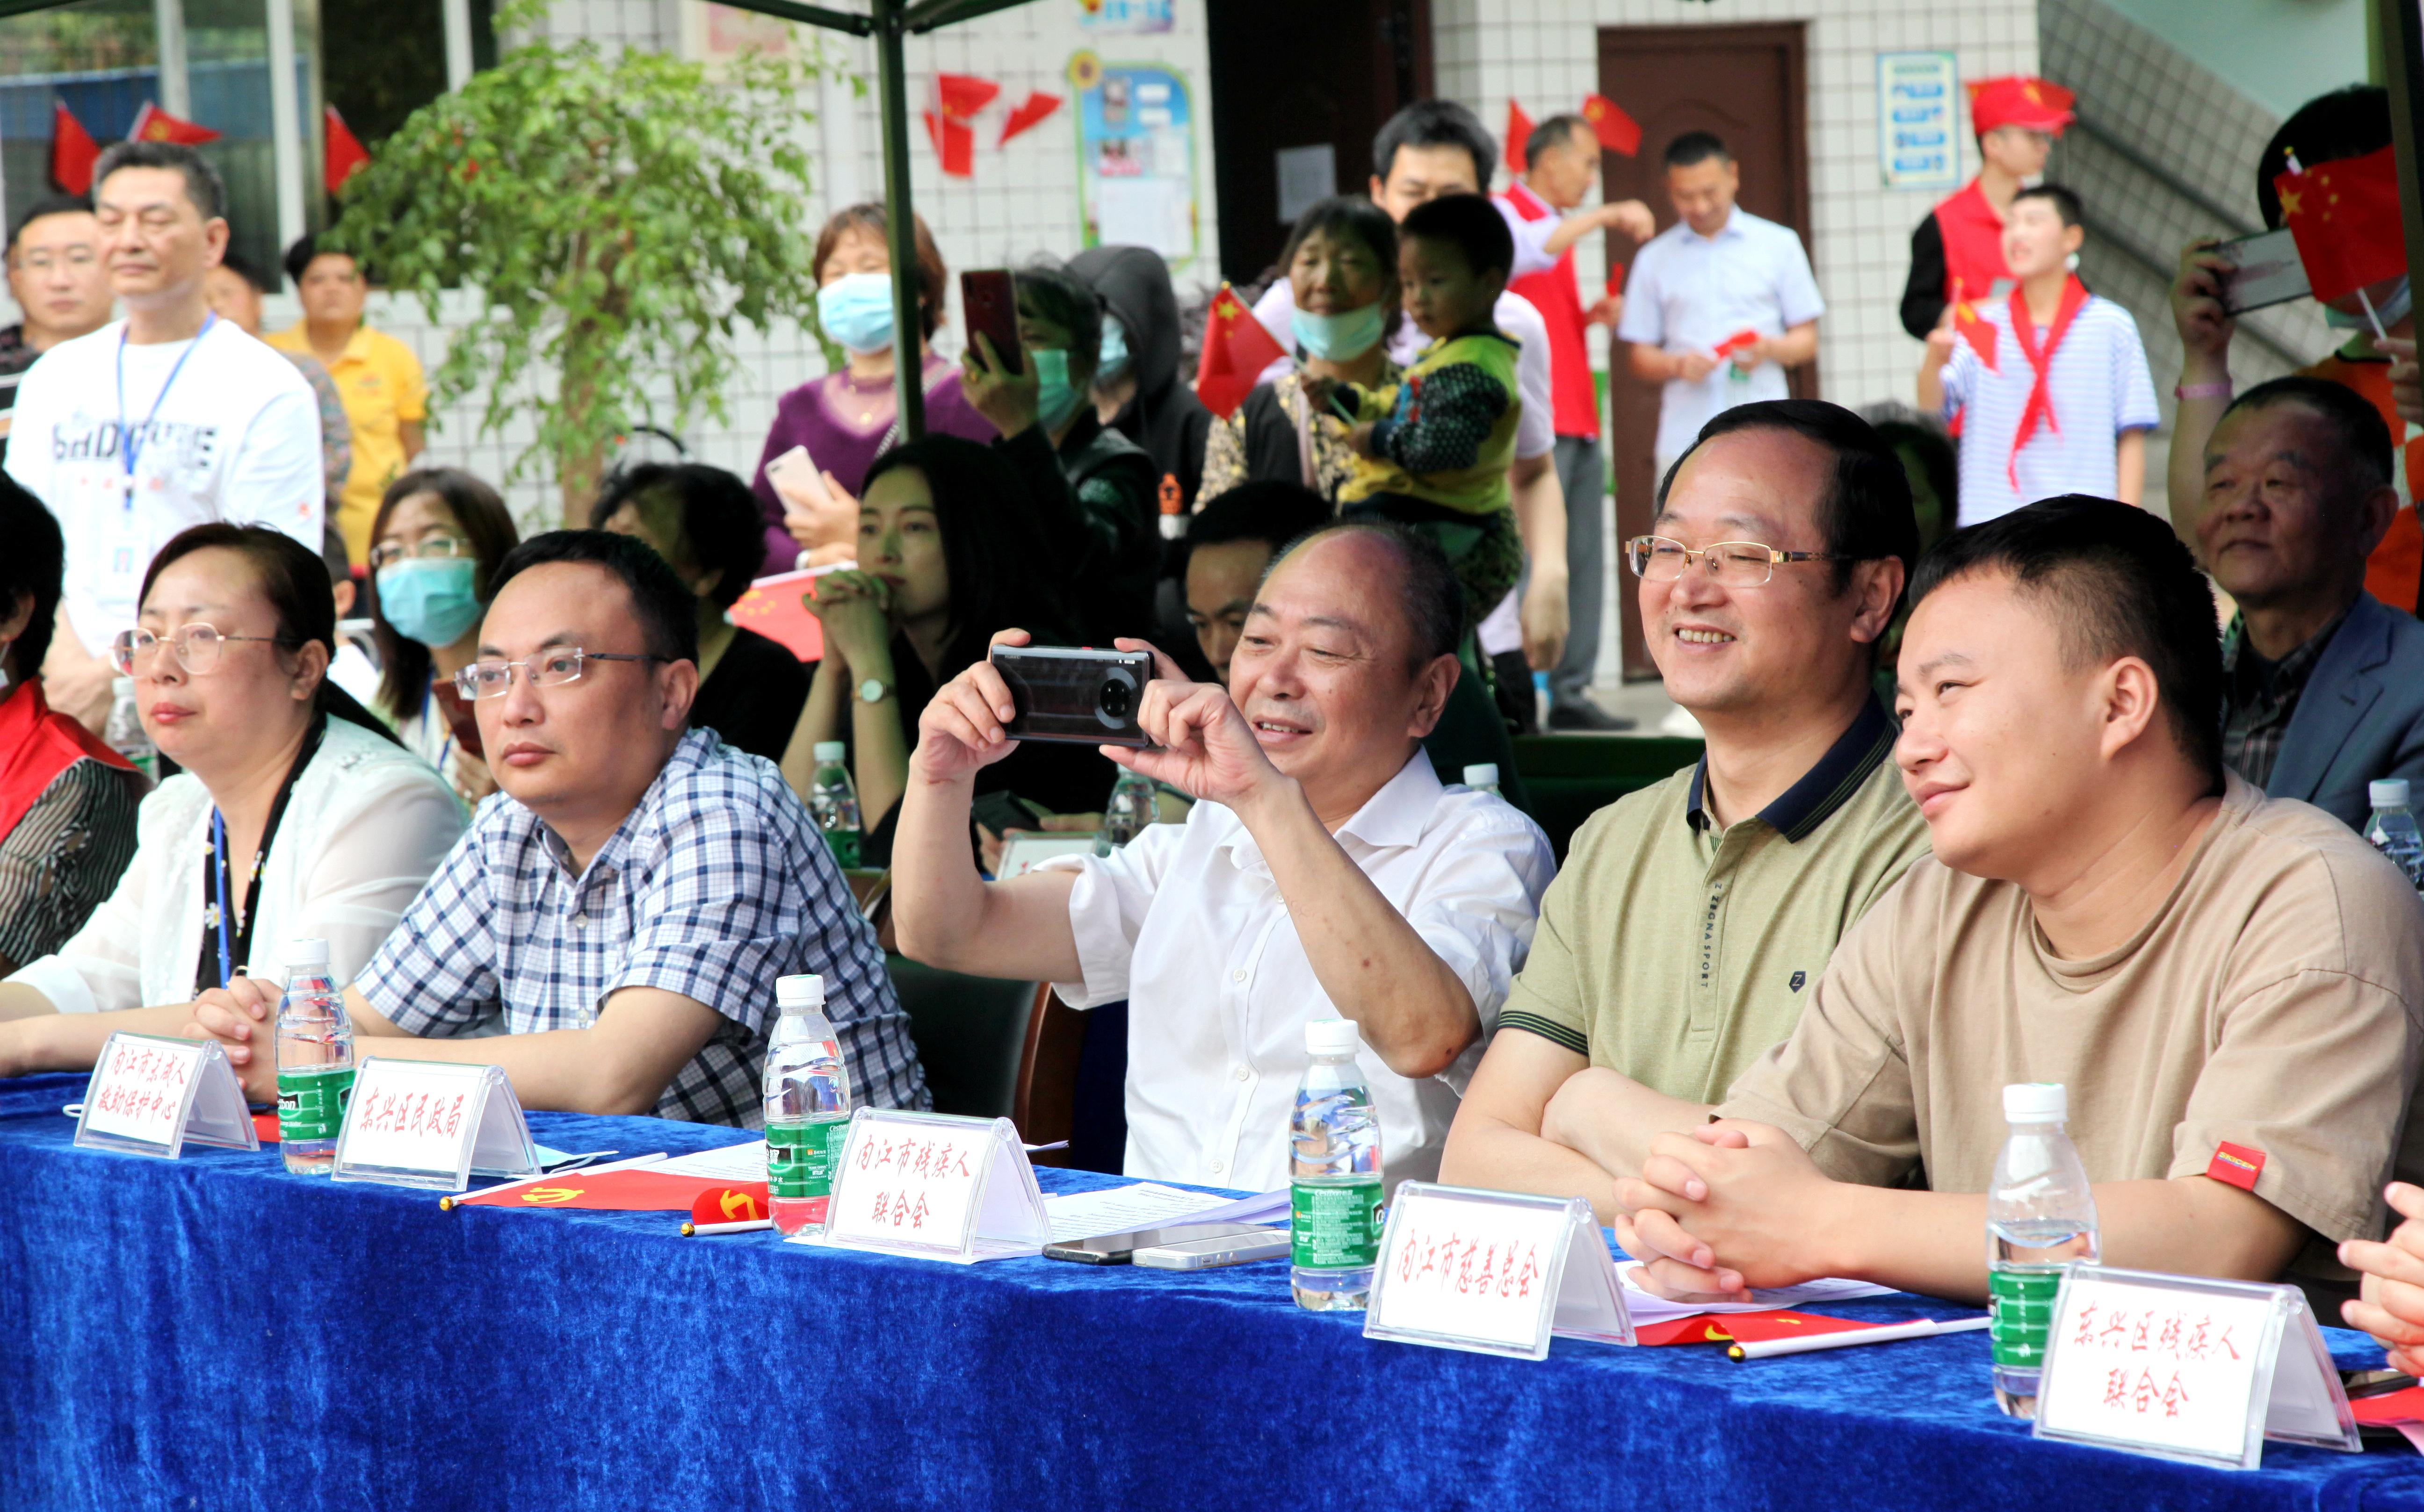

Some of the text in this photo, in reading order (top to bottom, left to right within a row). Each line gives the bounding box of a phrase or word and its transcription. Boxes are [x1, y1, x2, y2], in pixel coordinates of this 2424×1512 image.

[1701, 945, 1711, 988] SPORT
[360, 1086, 464, 1139] 东兴区民政局
[856, 1134, 970, 1180] 内江市残疾人
[872, 1189, 929, 1229] 联合会
[1397, 1228, 1538, 1298] 内江市慈善总会
[2074, 1300, 2241, 1361] 东兴区残疾人
[2103, 1366, 2189, 1418] 联合会
